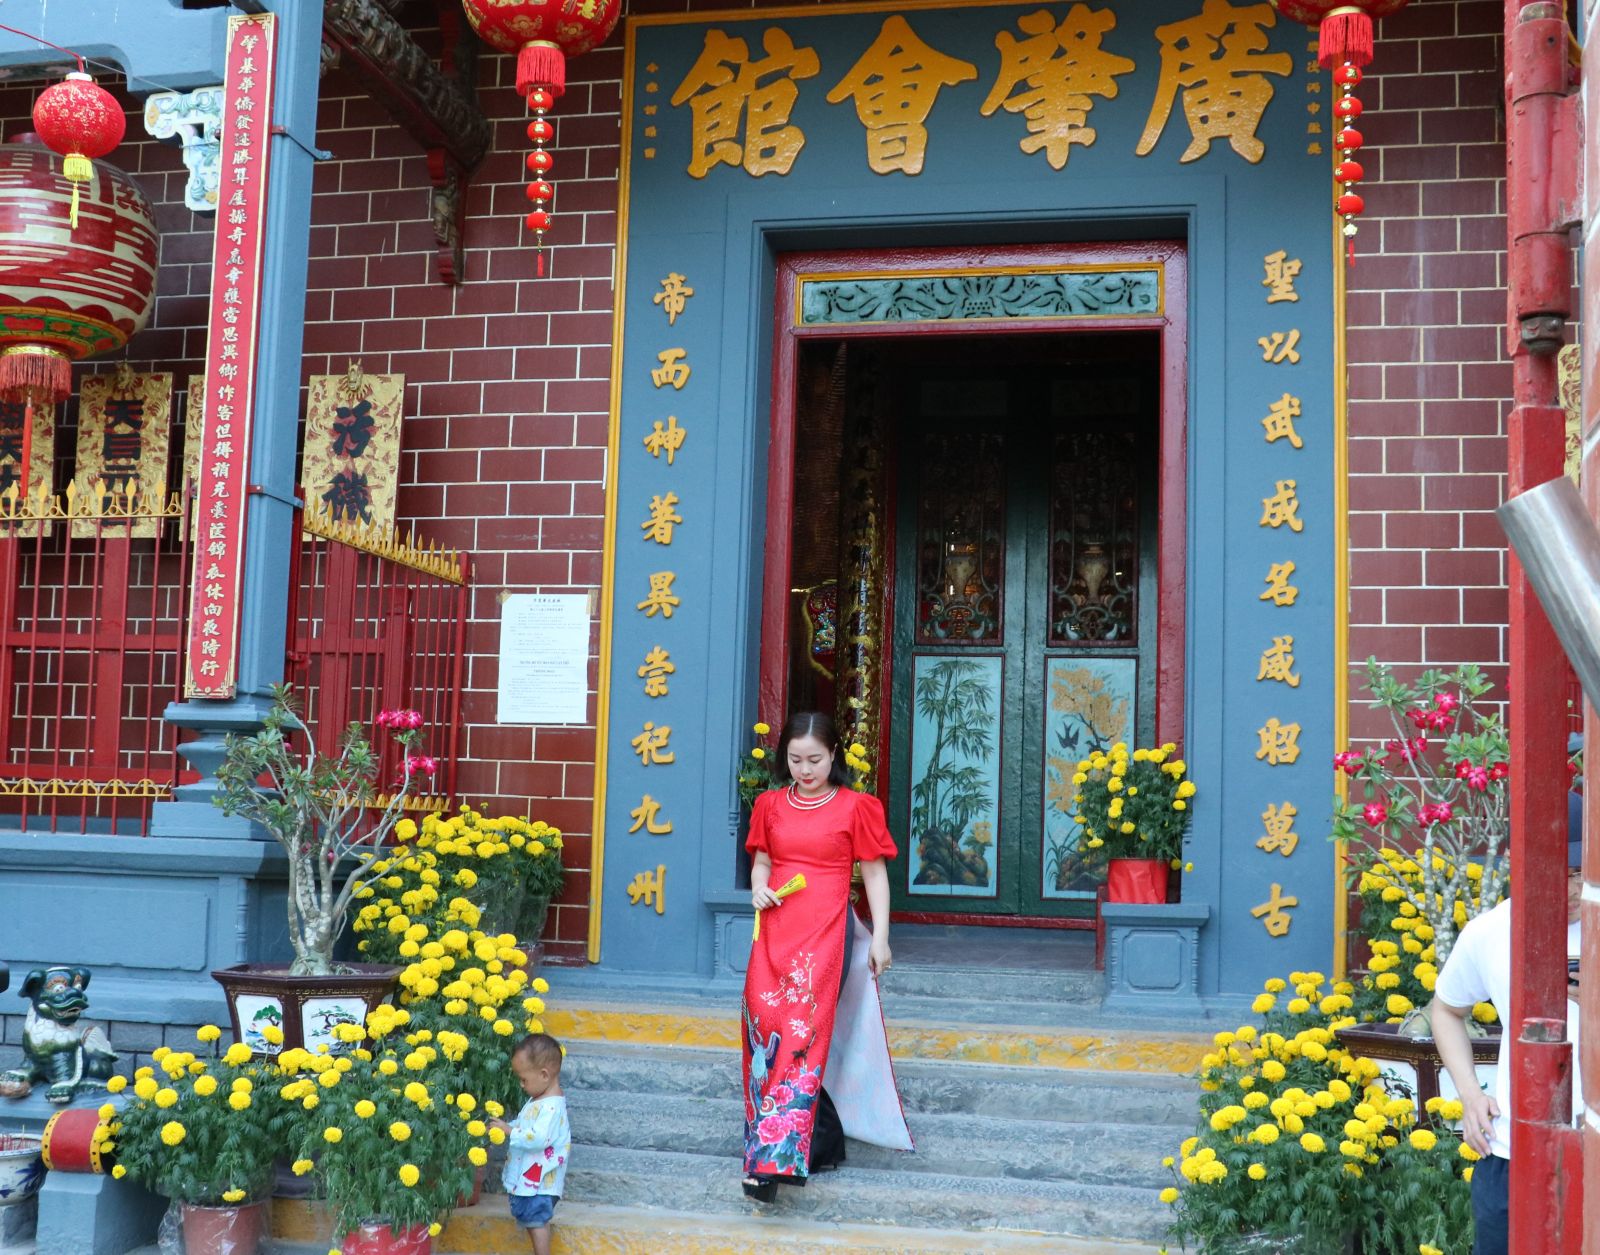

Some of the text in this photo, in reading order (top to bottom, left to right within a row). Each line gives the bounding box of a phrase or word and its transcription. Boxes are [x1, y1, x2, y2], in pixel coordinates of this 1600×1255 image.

[670, 0, 1293, 179] 廣肇會館
[627, 271, 694, 915] 帝而神著異崇祀九州
[1251, 249, 1303, 937] 聖以武成名威昭萬古
